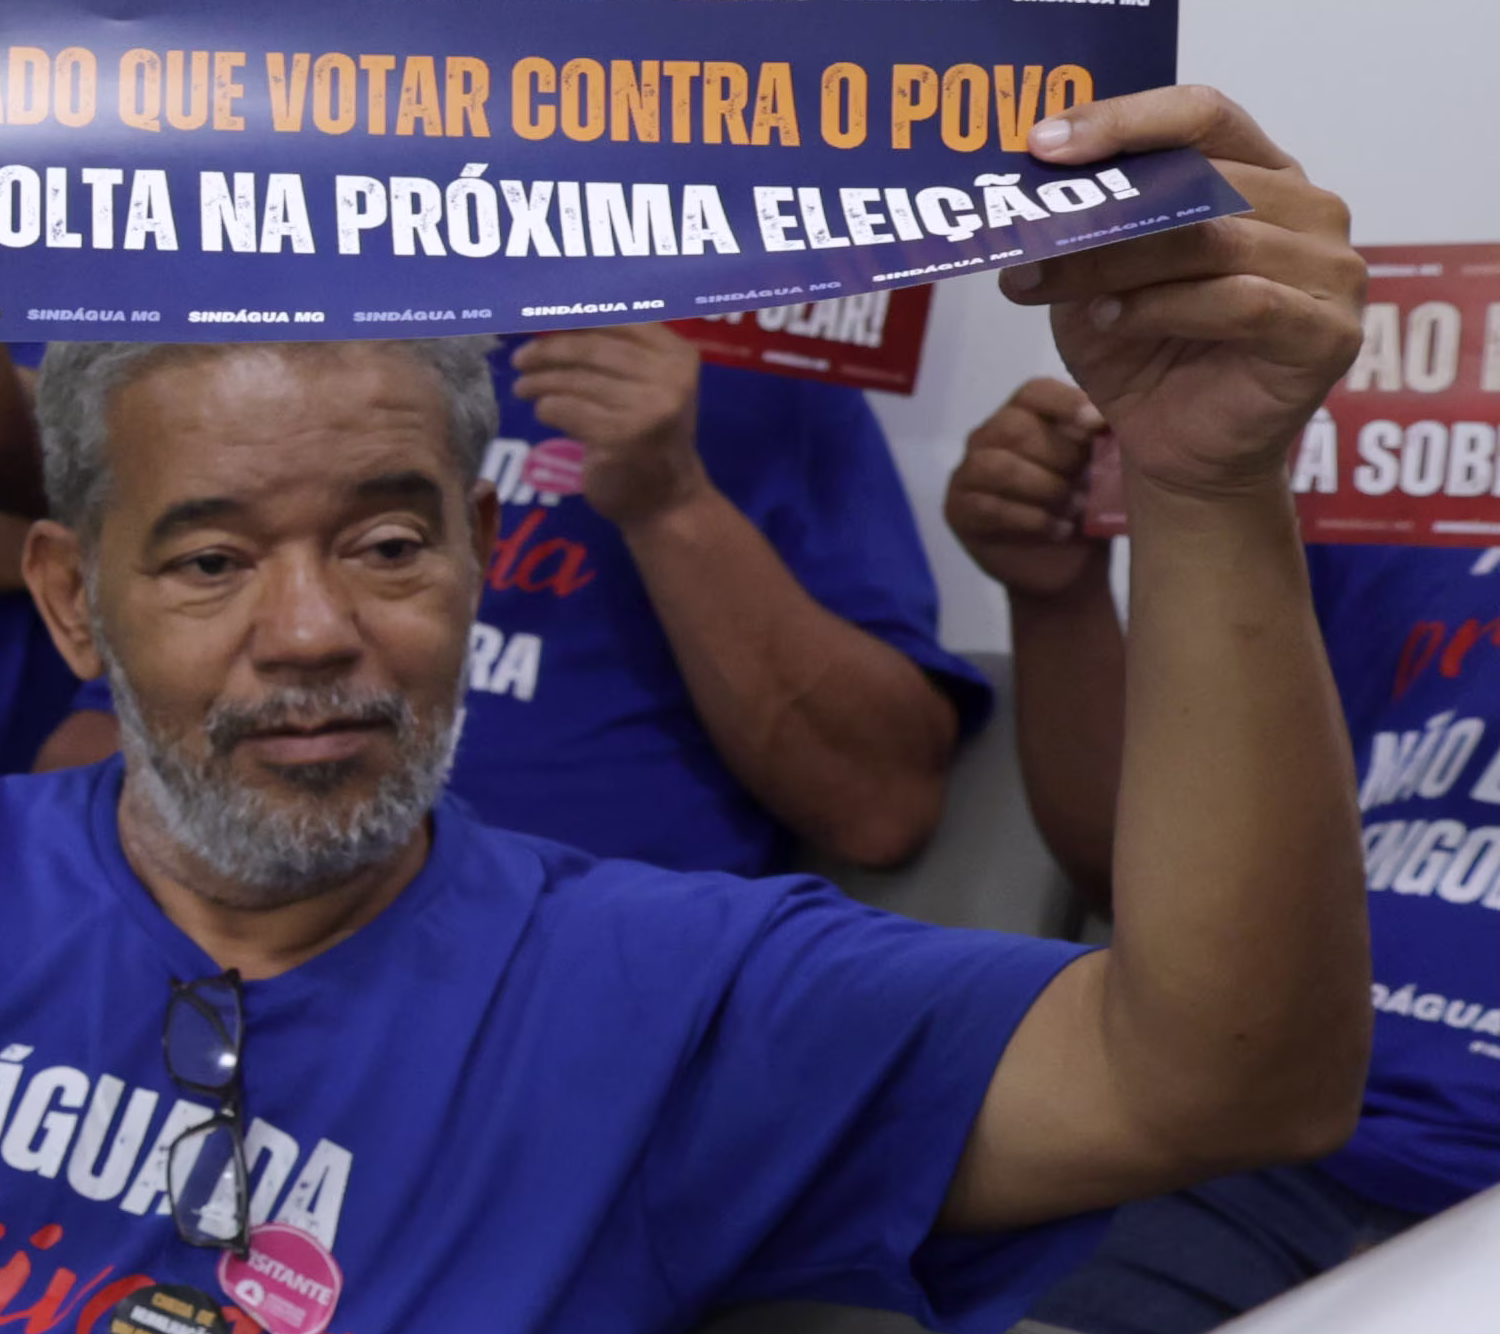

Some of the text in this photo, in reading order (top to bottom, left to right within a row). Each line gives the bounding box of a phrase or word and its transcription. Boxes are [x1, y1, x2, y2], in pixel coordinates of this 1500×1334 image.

[118, 48, 245, 134] QUE
[266, 52, 491, 137] VOTAR
[511, 57, 800, 147] CONTRA
[821, 62, 867, 150] O
[200, 171, 316, 255] NA
[335, 164, 740, 257] PRÓXIMA
[753, 168, 1140, 252] ELEIÇÃO!
[522, 300, 664, 318] SINDÁGUA MG
[1345, 301, 1460, 393] AO
[247, 1250, 334, 1307] ISITANTE
